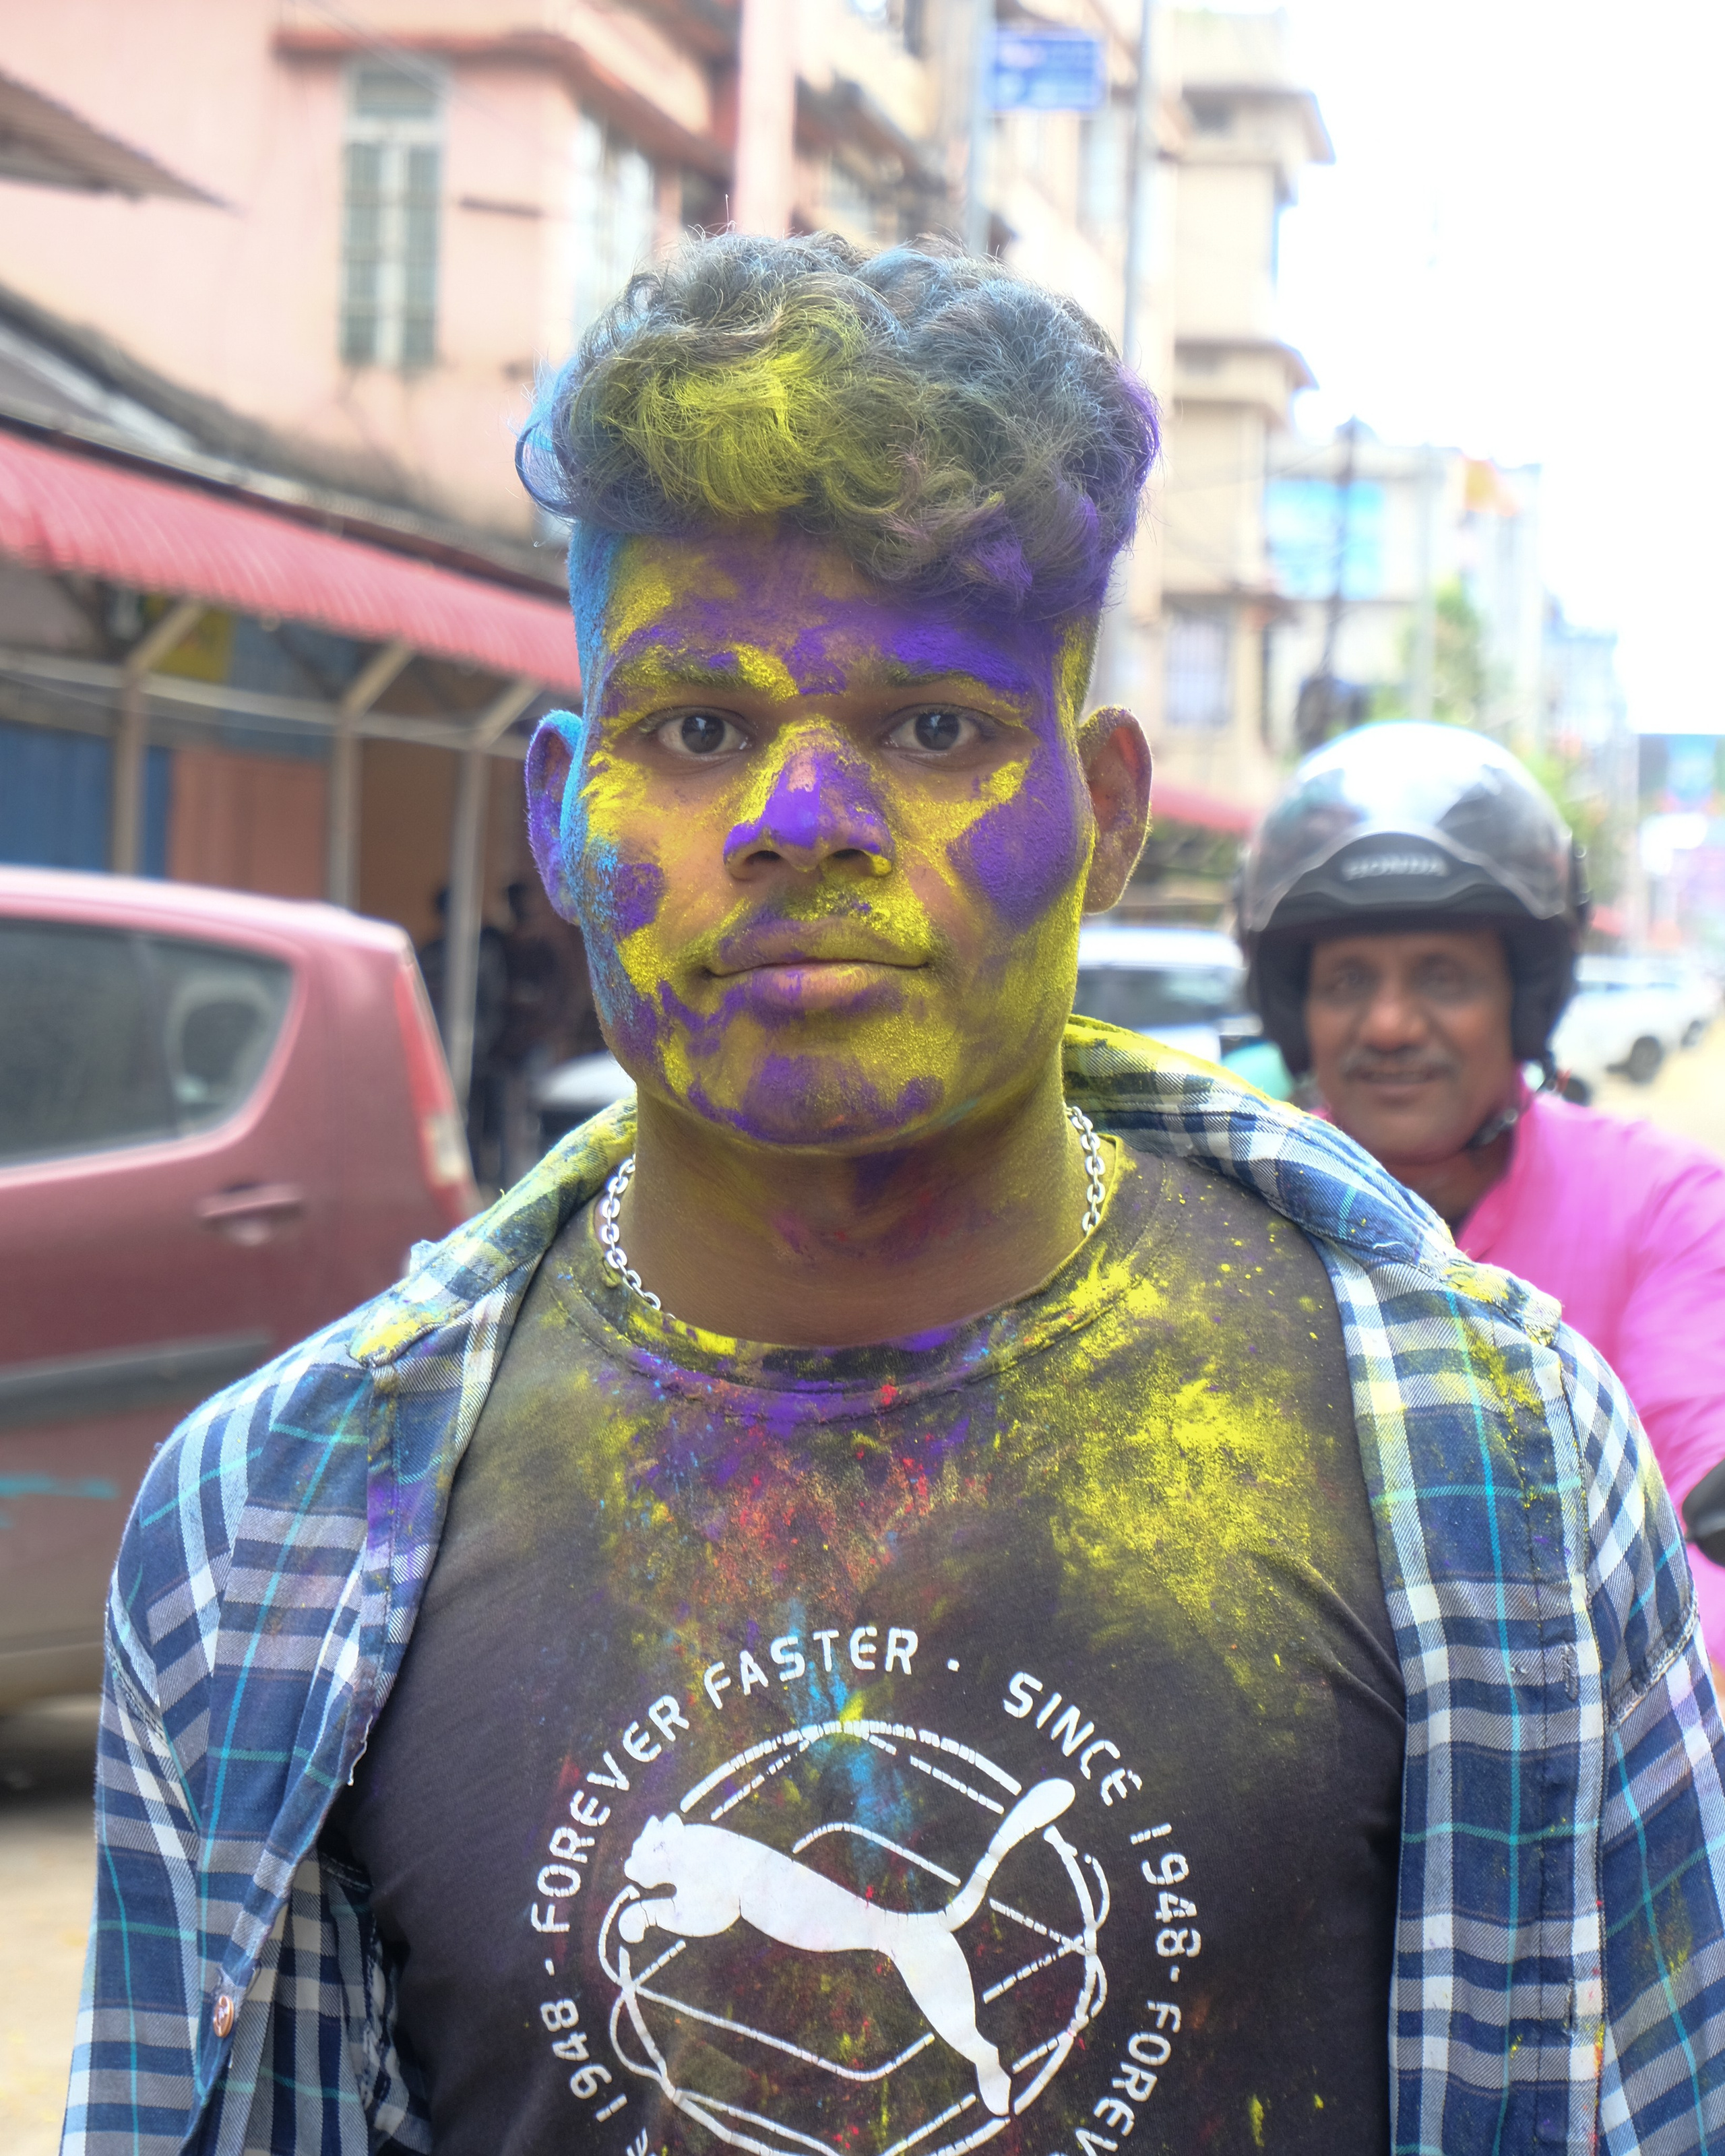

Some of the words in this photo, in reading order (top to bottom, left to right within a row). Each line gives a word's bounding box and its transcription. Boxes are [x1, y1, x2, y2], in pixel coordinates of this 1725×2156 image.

[703, 1626, 918, 1710] FASTER
[1003, 1671, 1143, 1807] SINCE
[531, 1694, 690, 1932] FOREVER
[540, 1998, 627, 2122] 1948
[1048, 2000, 1181, 2156] FOREV
